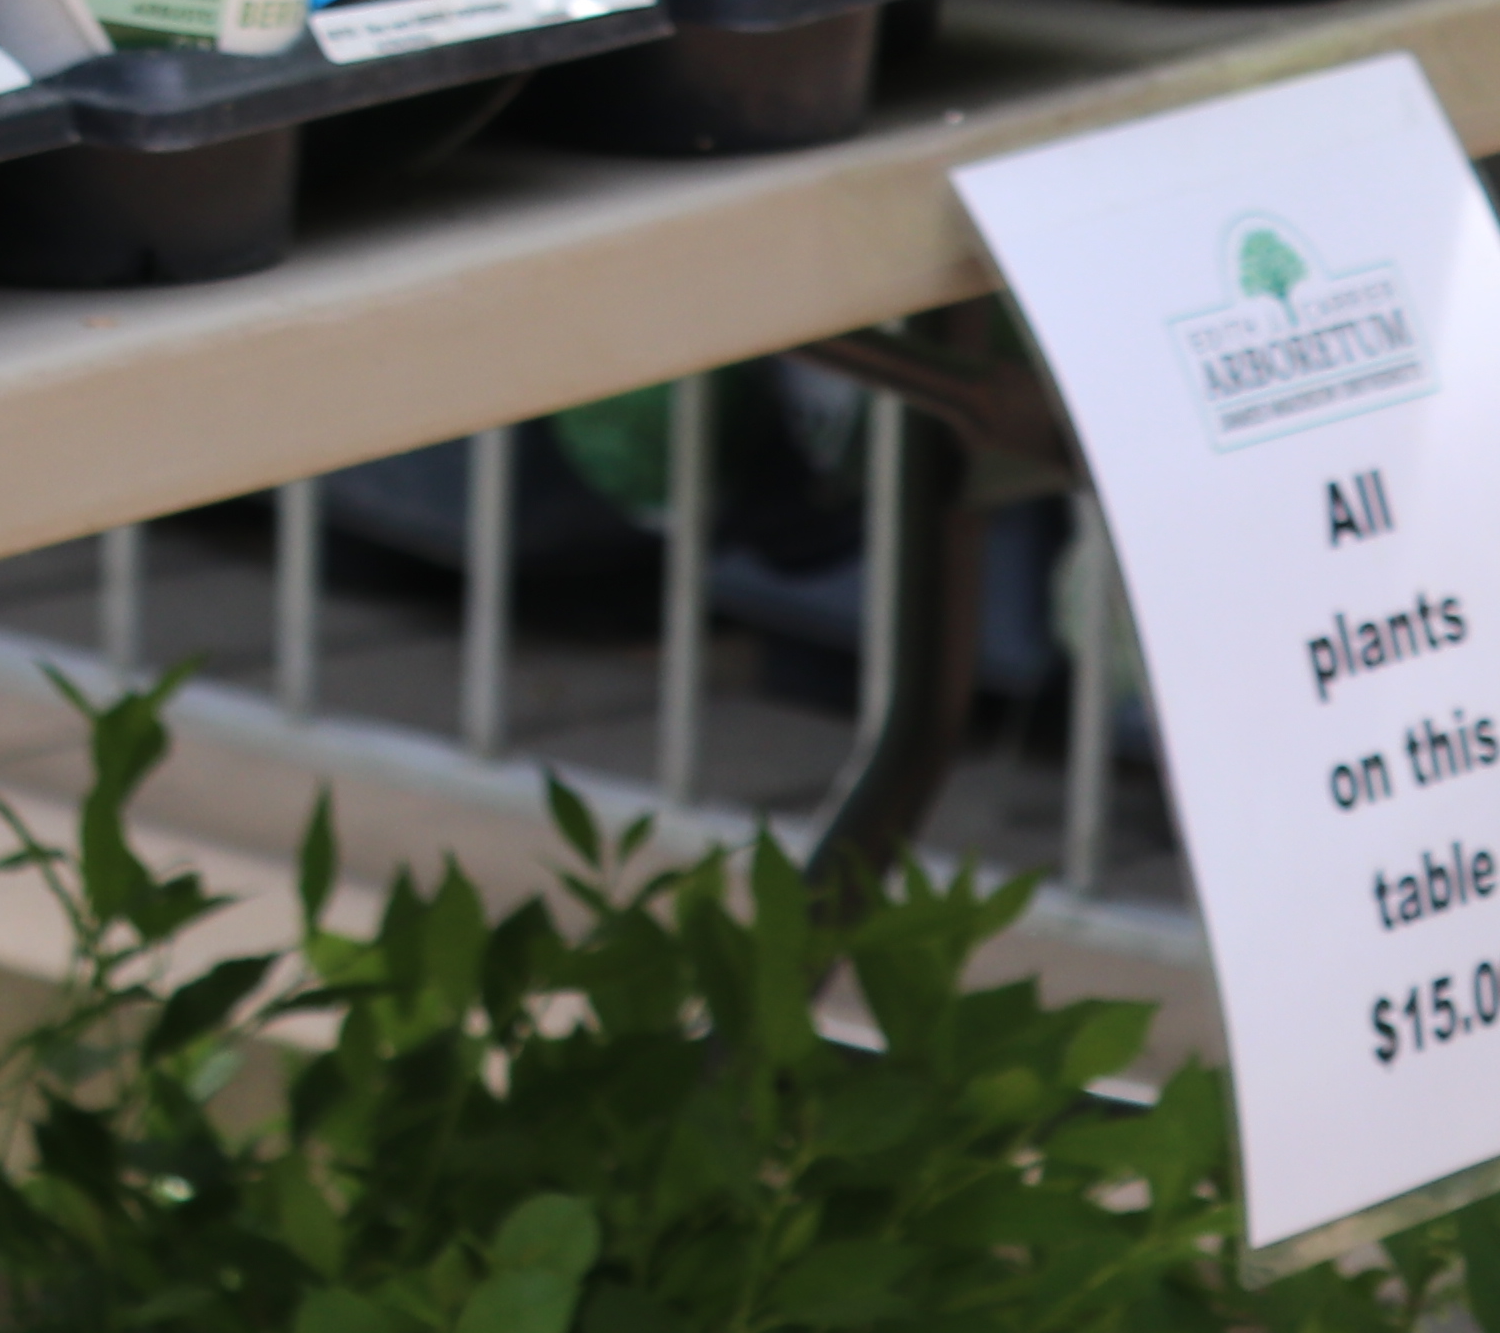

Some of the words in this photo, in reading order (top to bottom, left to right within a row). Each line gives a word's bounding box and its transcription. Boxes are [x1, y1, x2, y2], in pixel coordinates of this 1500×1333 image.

[1204, 308, 1413, 401] ARBORETUM
[1324, 469, 1397, 547] All
[1306, 592, 1467, 702] plants
[1330, 750, 1393, 811] on
[1406, 709, 1499, 788] this
[1373, 841, 1497, 931] table
